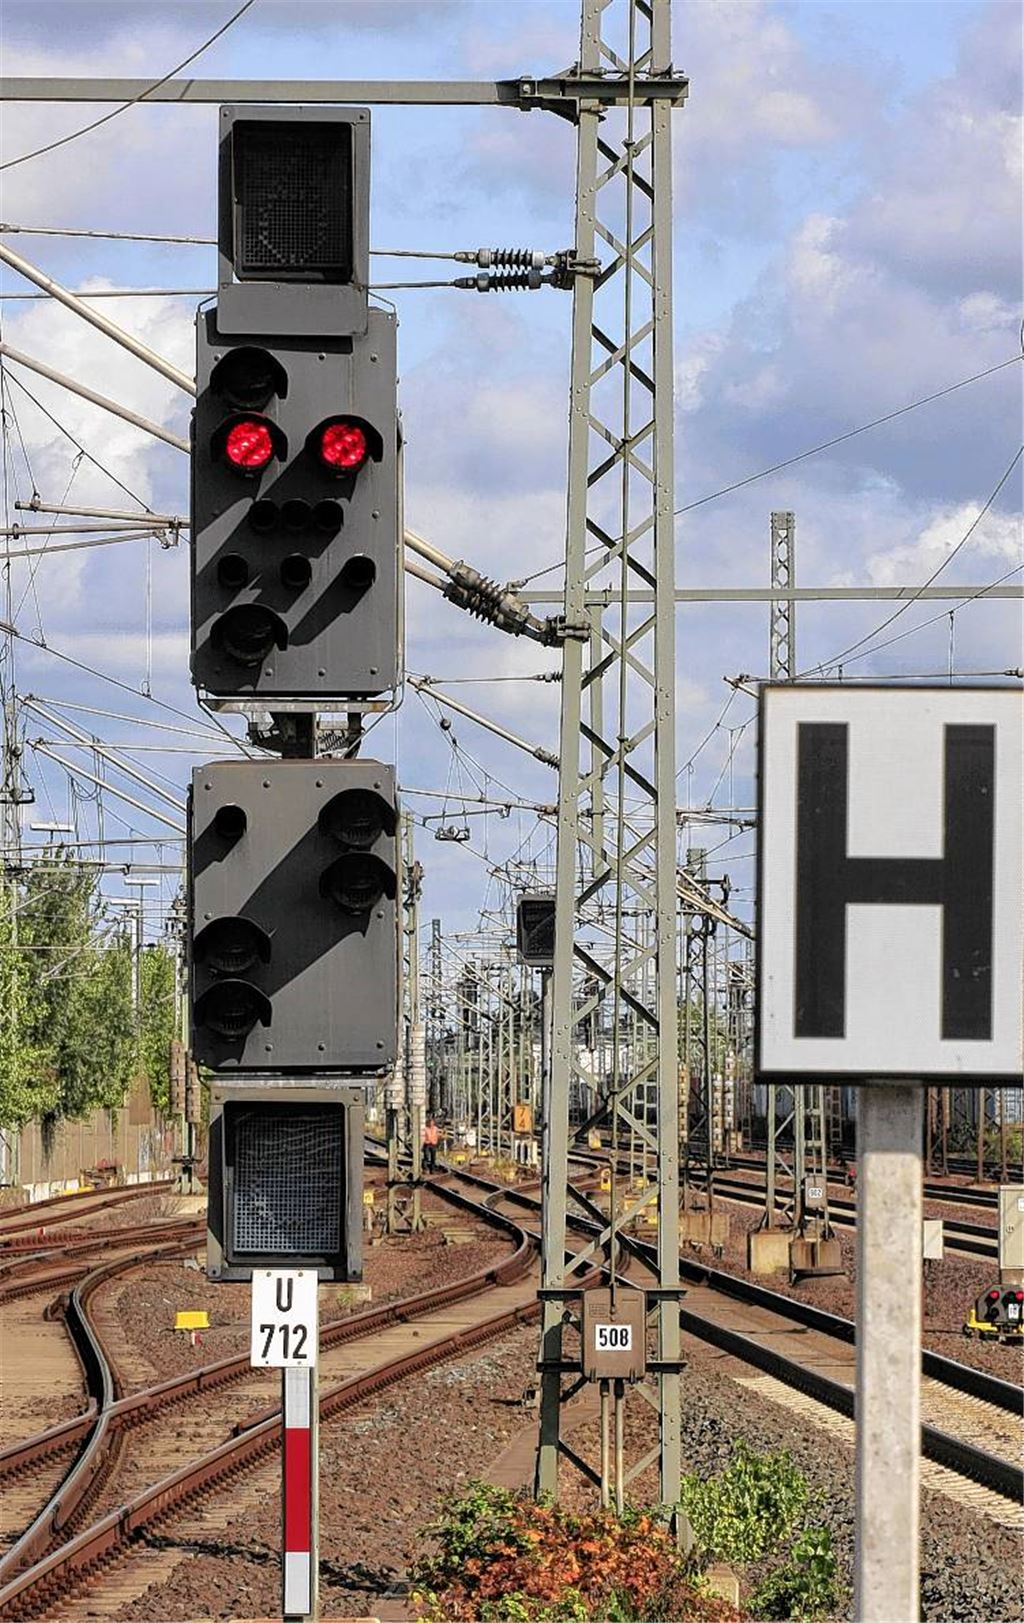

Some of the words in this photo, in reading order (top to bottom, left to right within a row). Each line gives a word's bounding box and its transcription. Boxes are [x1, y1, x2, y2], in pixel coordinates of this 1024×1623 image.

[794, 722, 996, 1041] H
[276, 1277, 293, 1312] U
[260, 1324, 307, 1359] 712
[599, 1328, 629, 1347] 508
